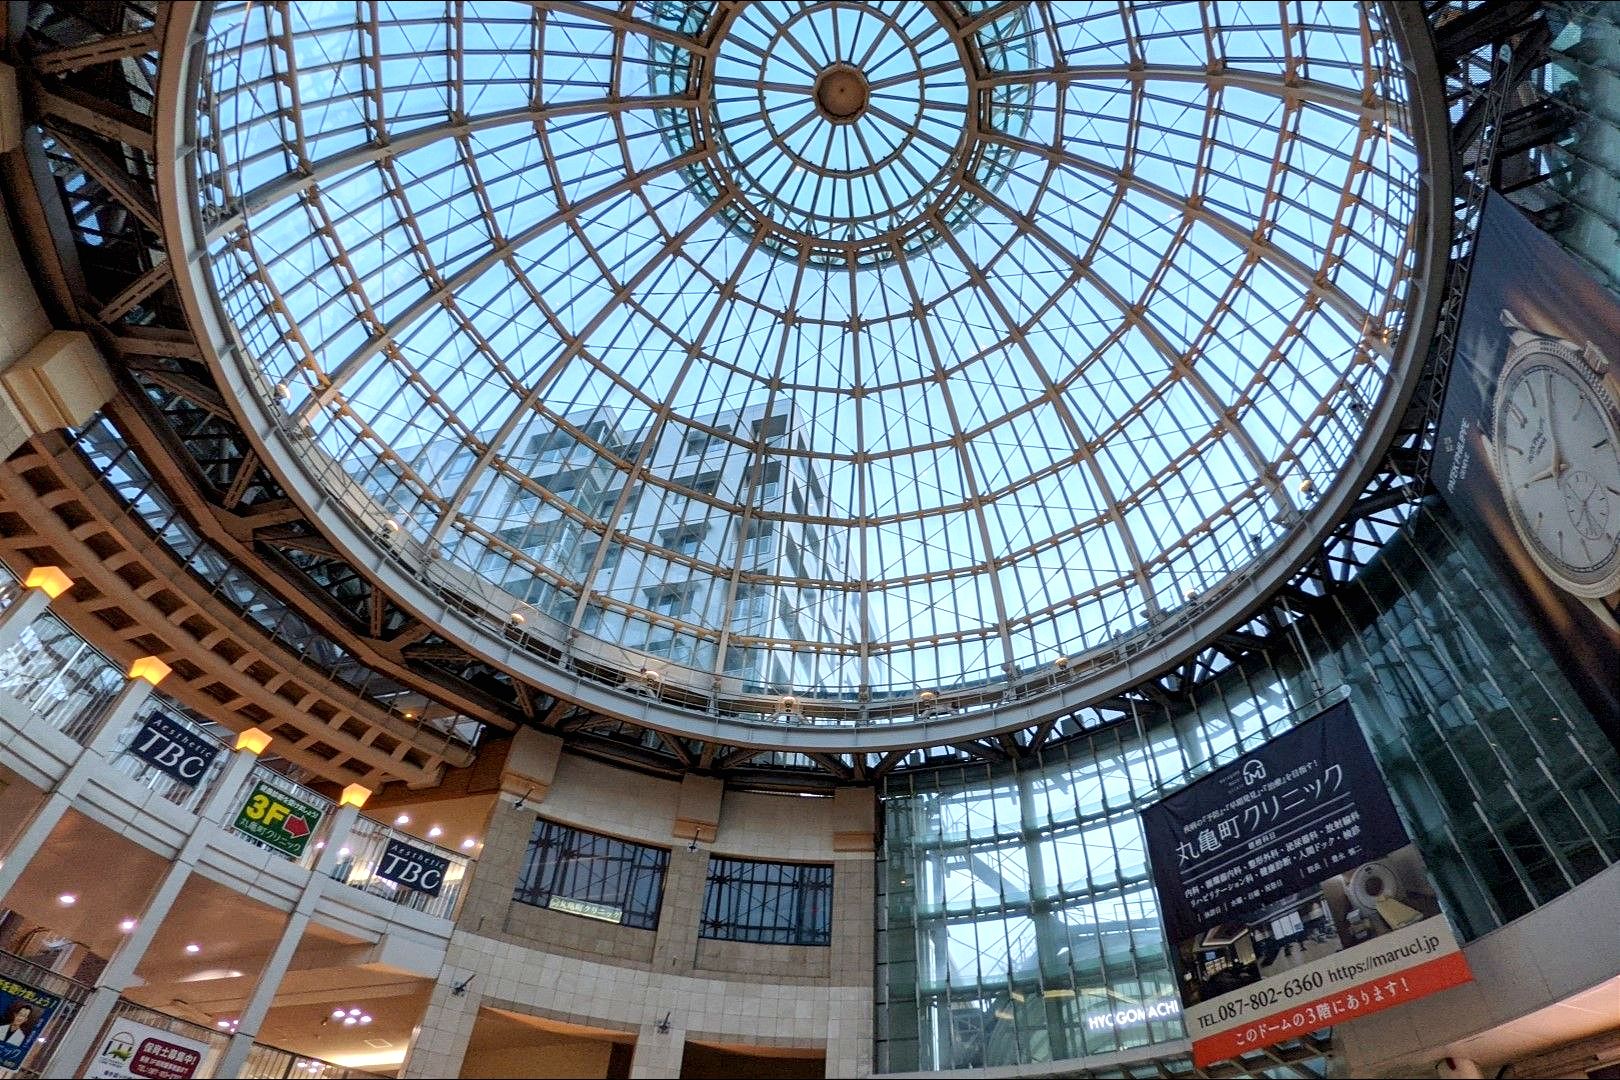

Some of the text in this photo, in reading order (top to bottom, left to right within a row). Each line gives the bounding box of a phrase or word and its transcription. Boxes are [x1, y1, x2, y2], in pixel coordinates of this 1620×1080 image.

[138, 727, 205, 778] TBC
[153, 718, 214, 757] Aesthetic
[246, 794, 290, 825] 3F
[1176, 763, 1344, 865] 丸亀町クリニック
[240, 817, 302, 851] 丸亀町クリニック
[383, 852, 441, 889] TBC
[391, 845, 446, 869] Aesthetic
[1327, 934, 1440, 983] https://marucl.jp
[1235, 977, 1409, 1046] このドームの3階にあります！
